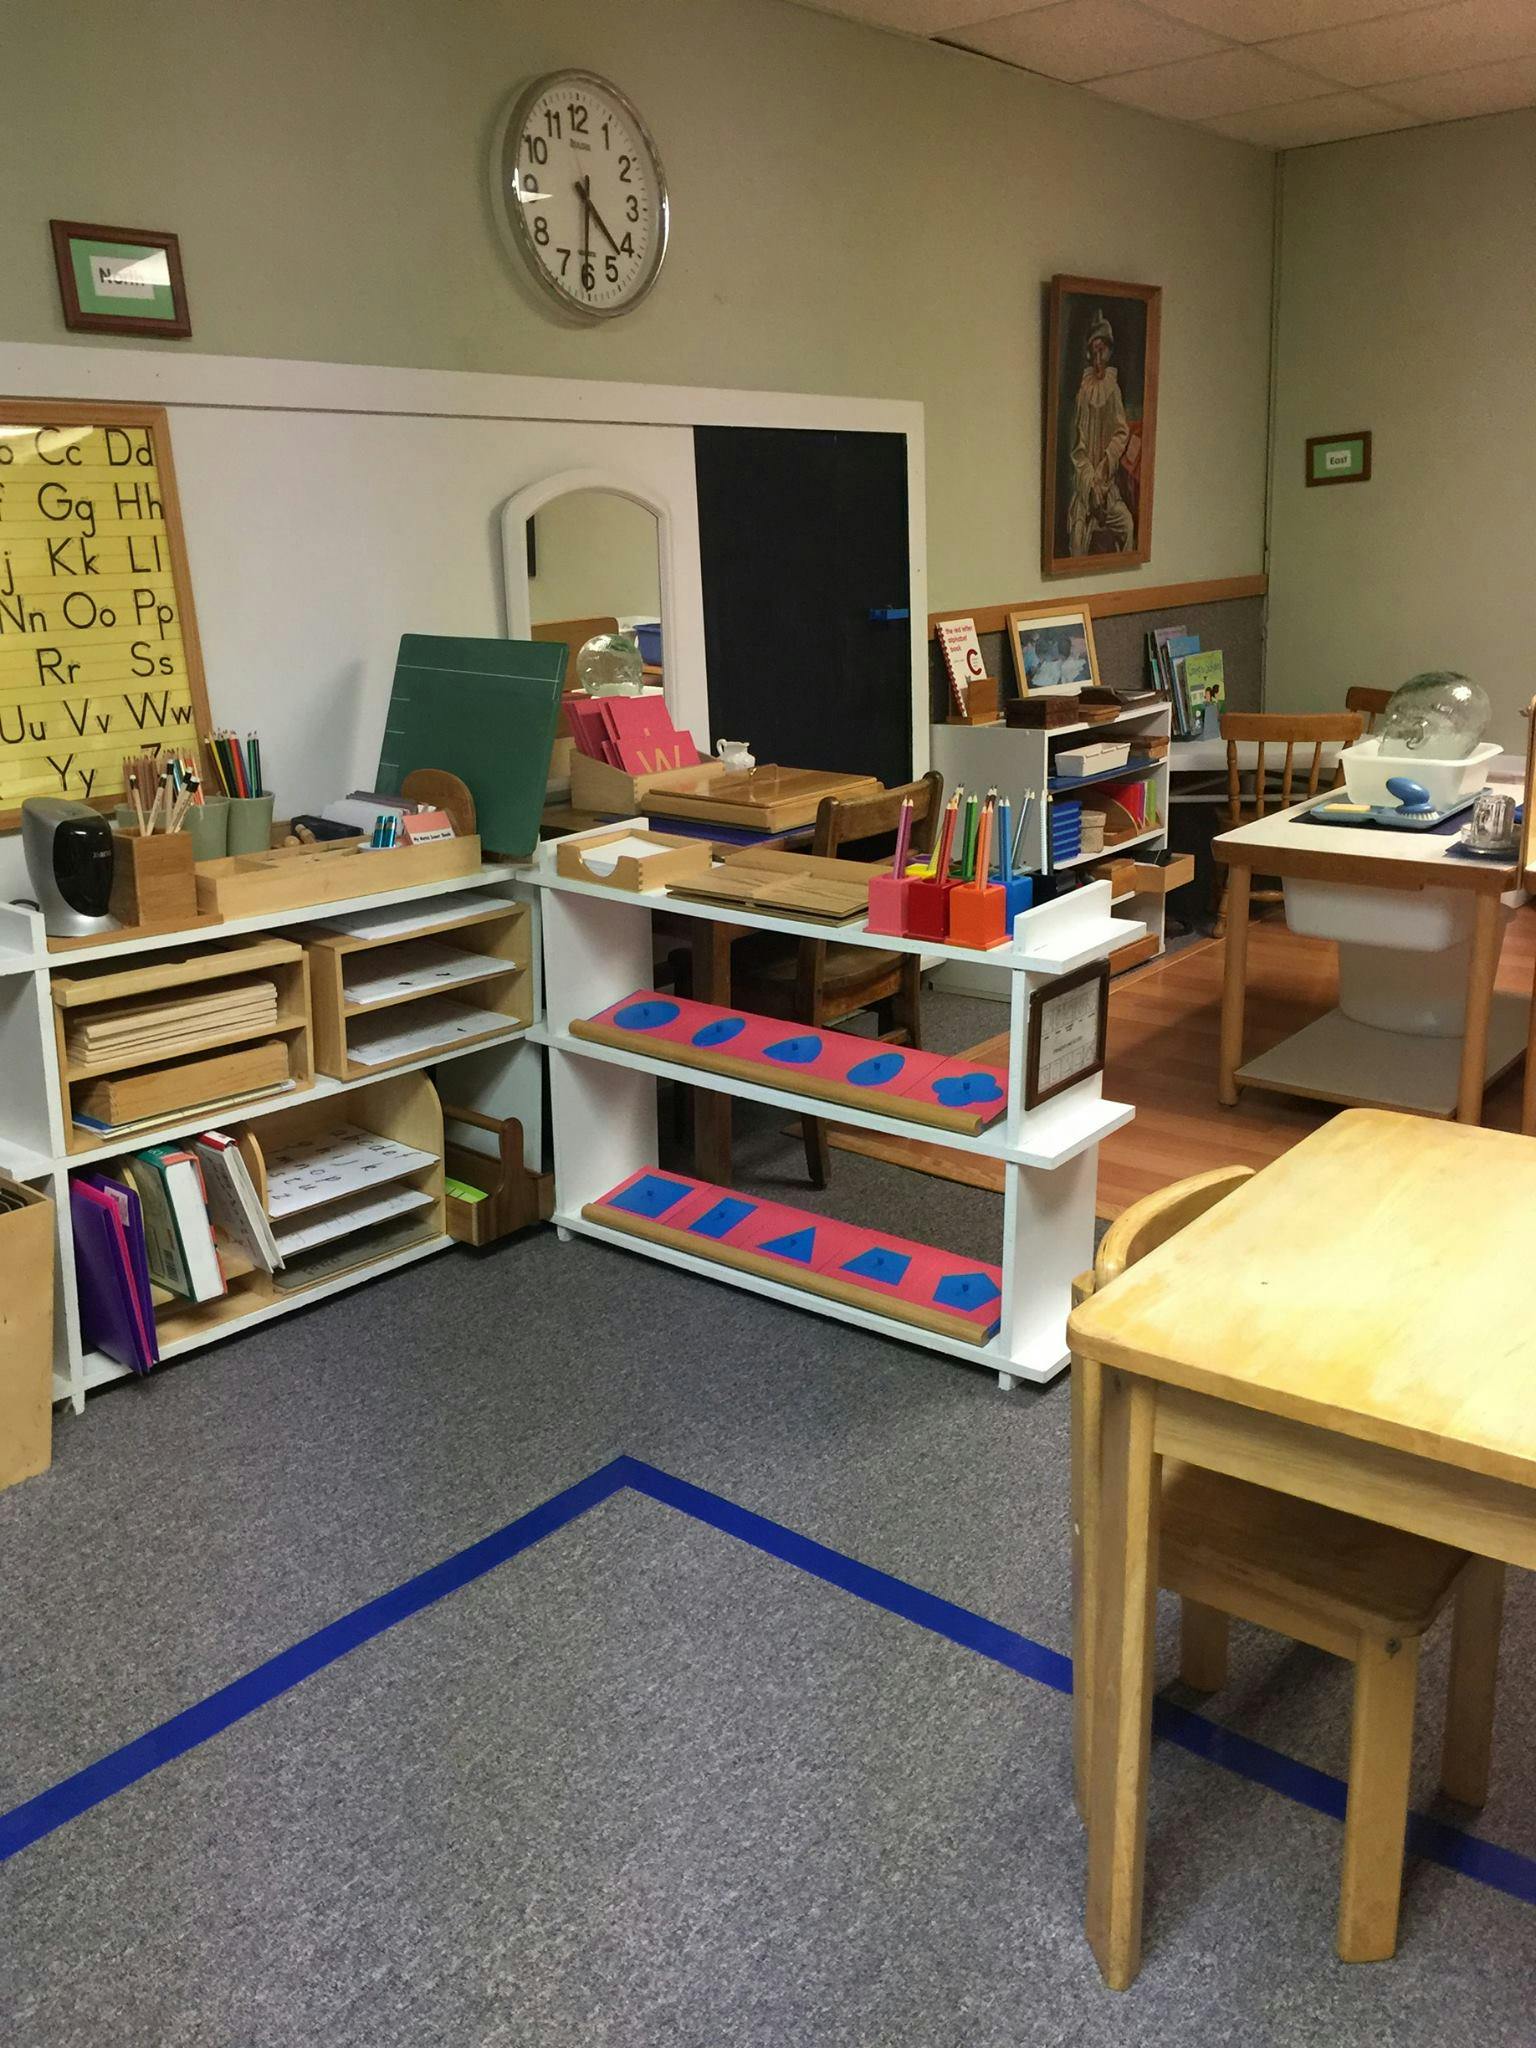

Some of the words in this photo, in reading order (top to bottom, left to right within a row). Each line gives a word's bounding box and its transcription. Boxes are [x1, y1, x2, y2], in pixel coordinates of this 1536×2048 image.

[544, 109, 562, 139] 11
[568, 104, 589, 134] 12
[523, 134, 548, 165] 10
[601, 122, 610, 150] 1
[618, 155, 632, 183] 2
[523, 174, 539, 203] 9
[626, 194, 640, 222] 3
[534, 216, 550, 246] 8
[620, 232, 635, 258] 4
[556, 248, 571, 276] 7
[605, 255, 619, 283] 5
[581, 263, 596, 292] 6
[35, 426, 82, 466] Cc
[106, 427, 154, 467] Dd
[38, 482, 95, 537] Gg
[115, 482, 164, 520] Hh
[47, 536, 100, 576] Kk
[0, 595, 47, 634] Nn
[63, 591, 116, 629] Oo
[134, 588, 174, 640] Pp
[36, 647, 80, 686] Rr
[131, 641, 174, 679] Ss
[0, 705, 47, 744] Uu
[64, 697, 110, 738] Vv
[124, 691, 192, 730] Ww
[47, 753, 96, 799] Yy
